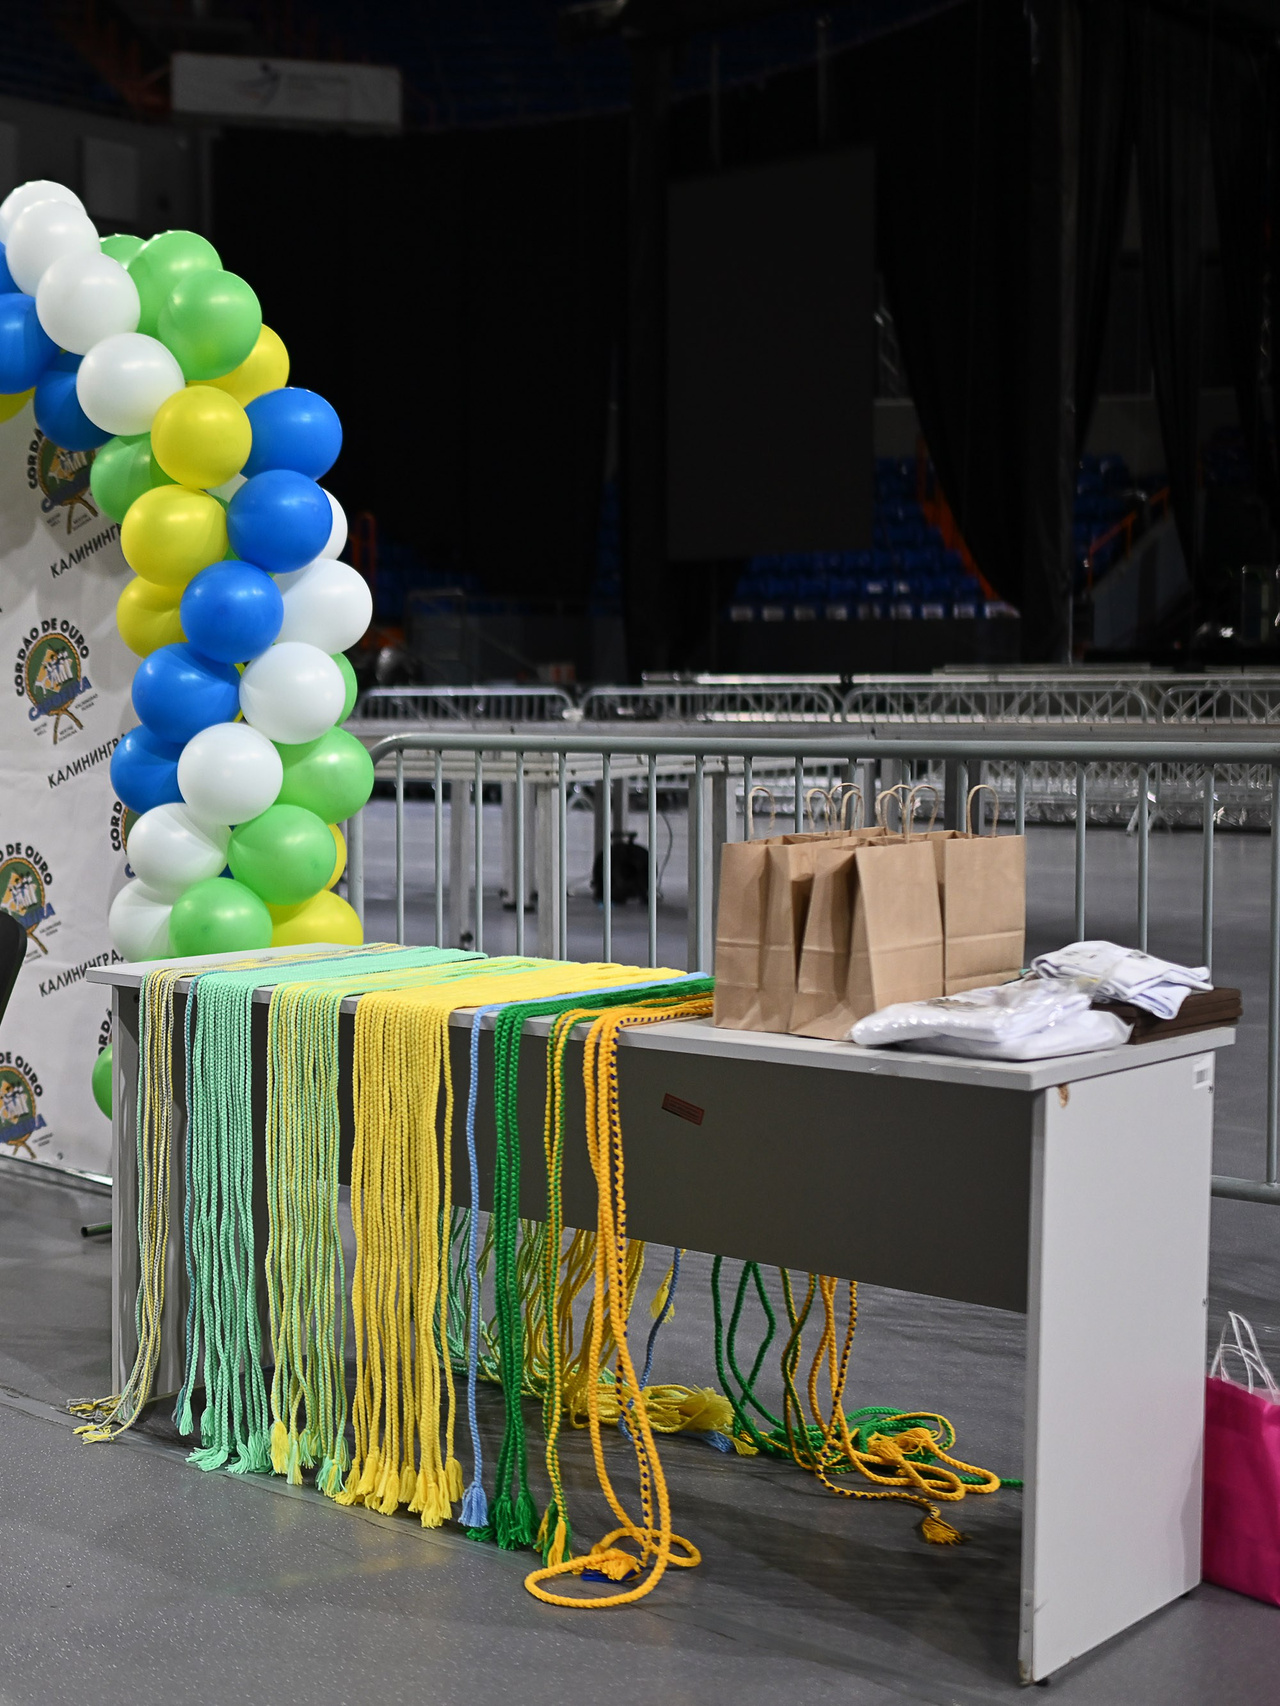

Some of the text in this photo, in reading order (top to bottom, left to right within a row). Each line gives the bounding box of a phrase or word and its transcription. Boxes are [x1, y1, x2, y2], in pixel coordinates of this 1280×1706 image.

[27, 427, 46, 490] CORDÃ
[50, 522, 122, 579] КАЛИНИНГ
[41, 617, 57, 632] DE
[60, 619, 90, 660] OURO
[47, 734, 125, 789] КАЛИНИНГР
[110, 801, 122, 852] CORD
[6, 842, 22, 856] DE
[25, 845, 53, 886] OURO
[38, 948, 124, 998] КАЛИНИНГРА
[15, 1056, 43, 1097] OURO
